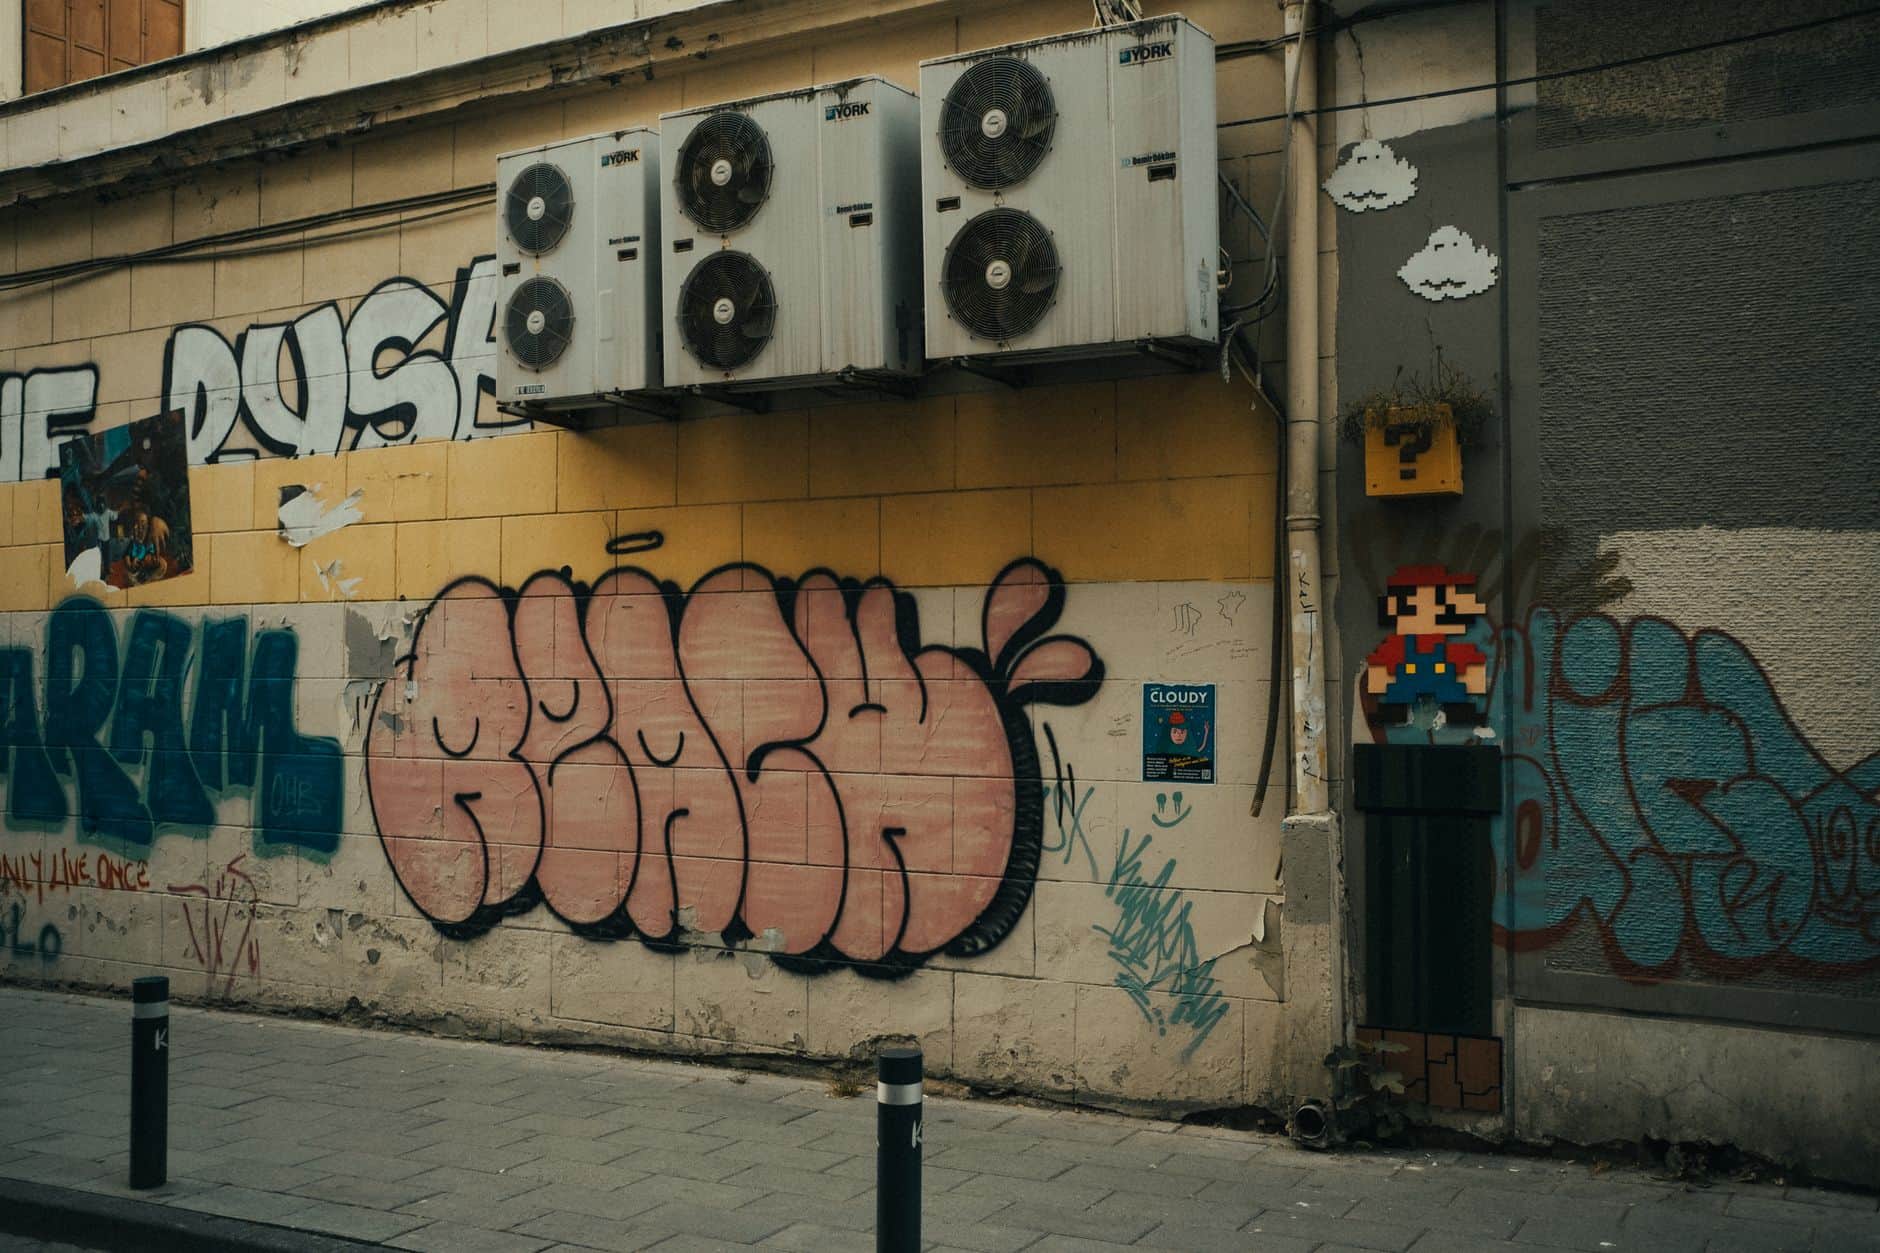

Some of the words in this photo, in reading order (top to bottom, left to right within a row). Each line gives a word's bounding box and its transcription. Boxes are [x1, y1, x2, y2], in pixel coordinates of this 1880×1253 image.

[1131, 43, 1172, 61] YORK
[835, 103, 869, 118] YORK
[608, 150, 639, 165] YORK
[1150, 691, 1207, 704] CLOUDY
[0, 848, 42, 905] NLY
[49, 847, 91, 893] LIVE
